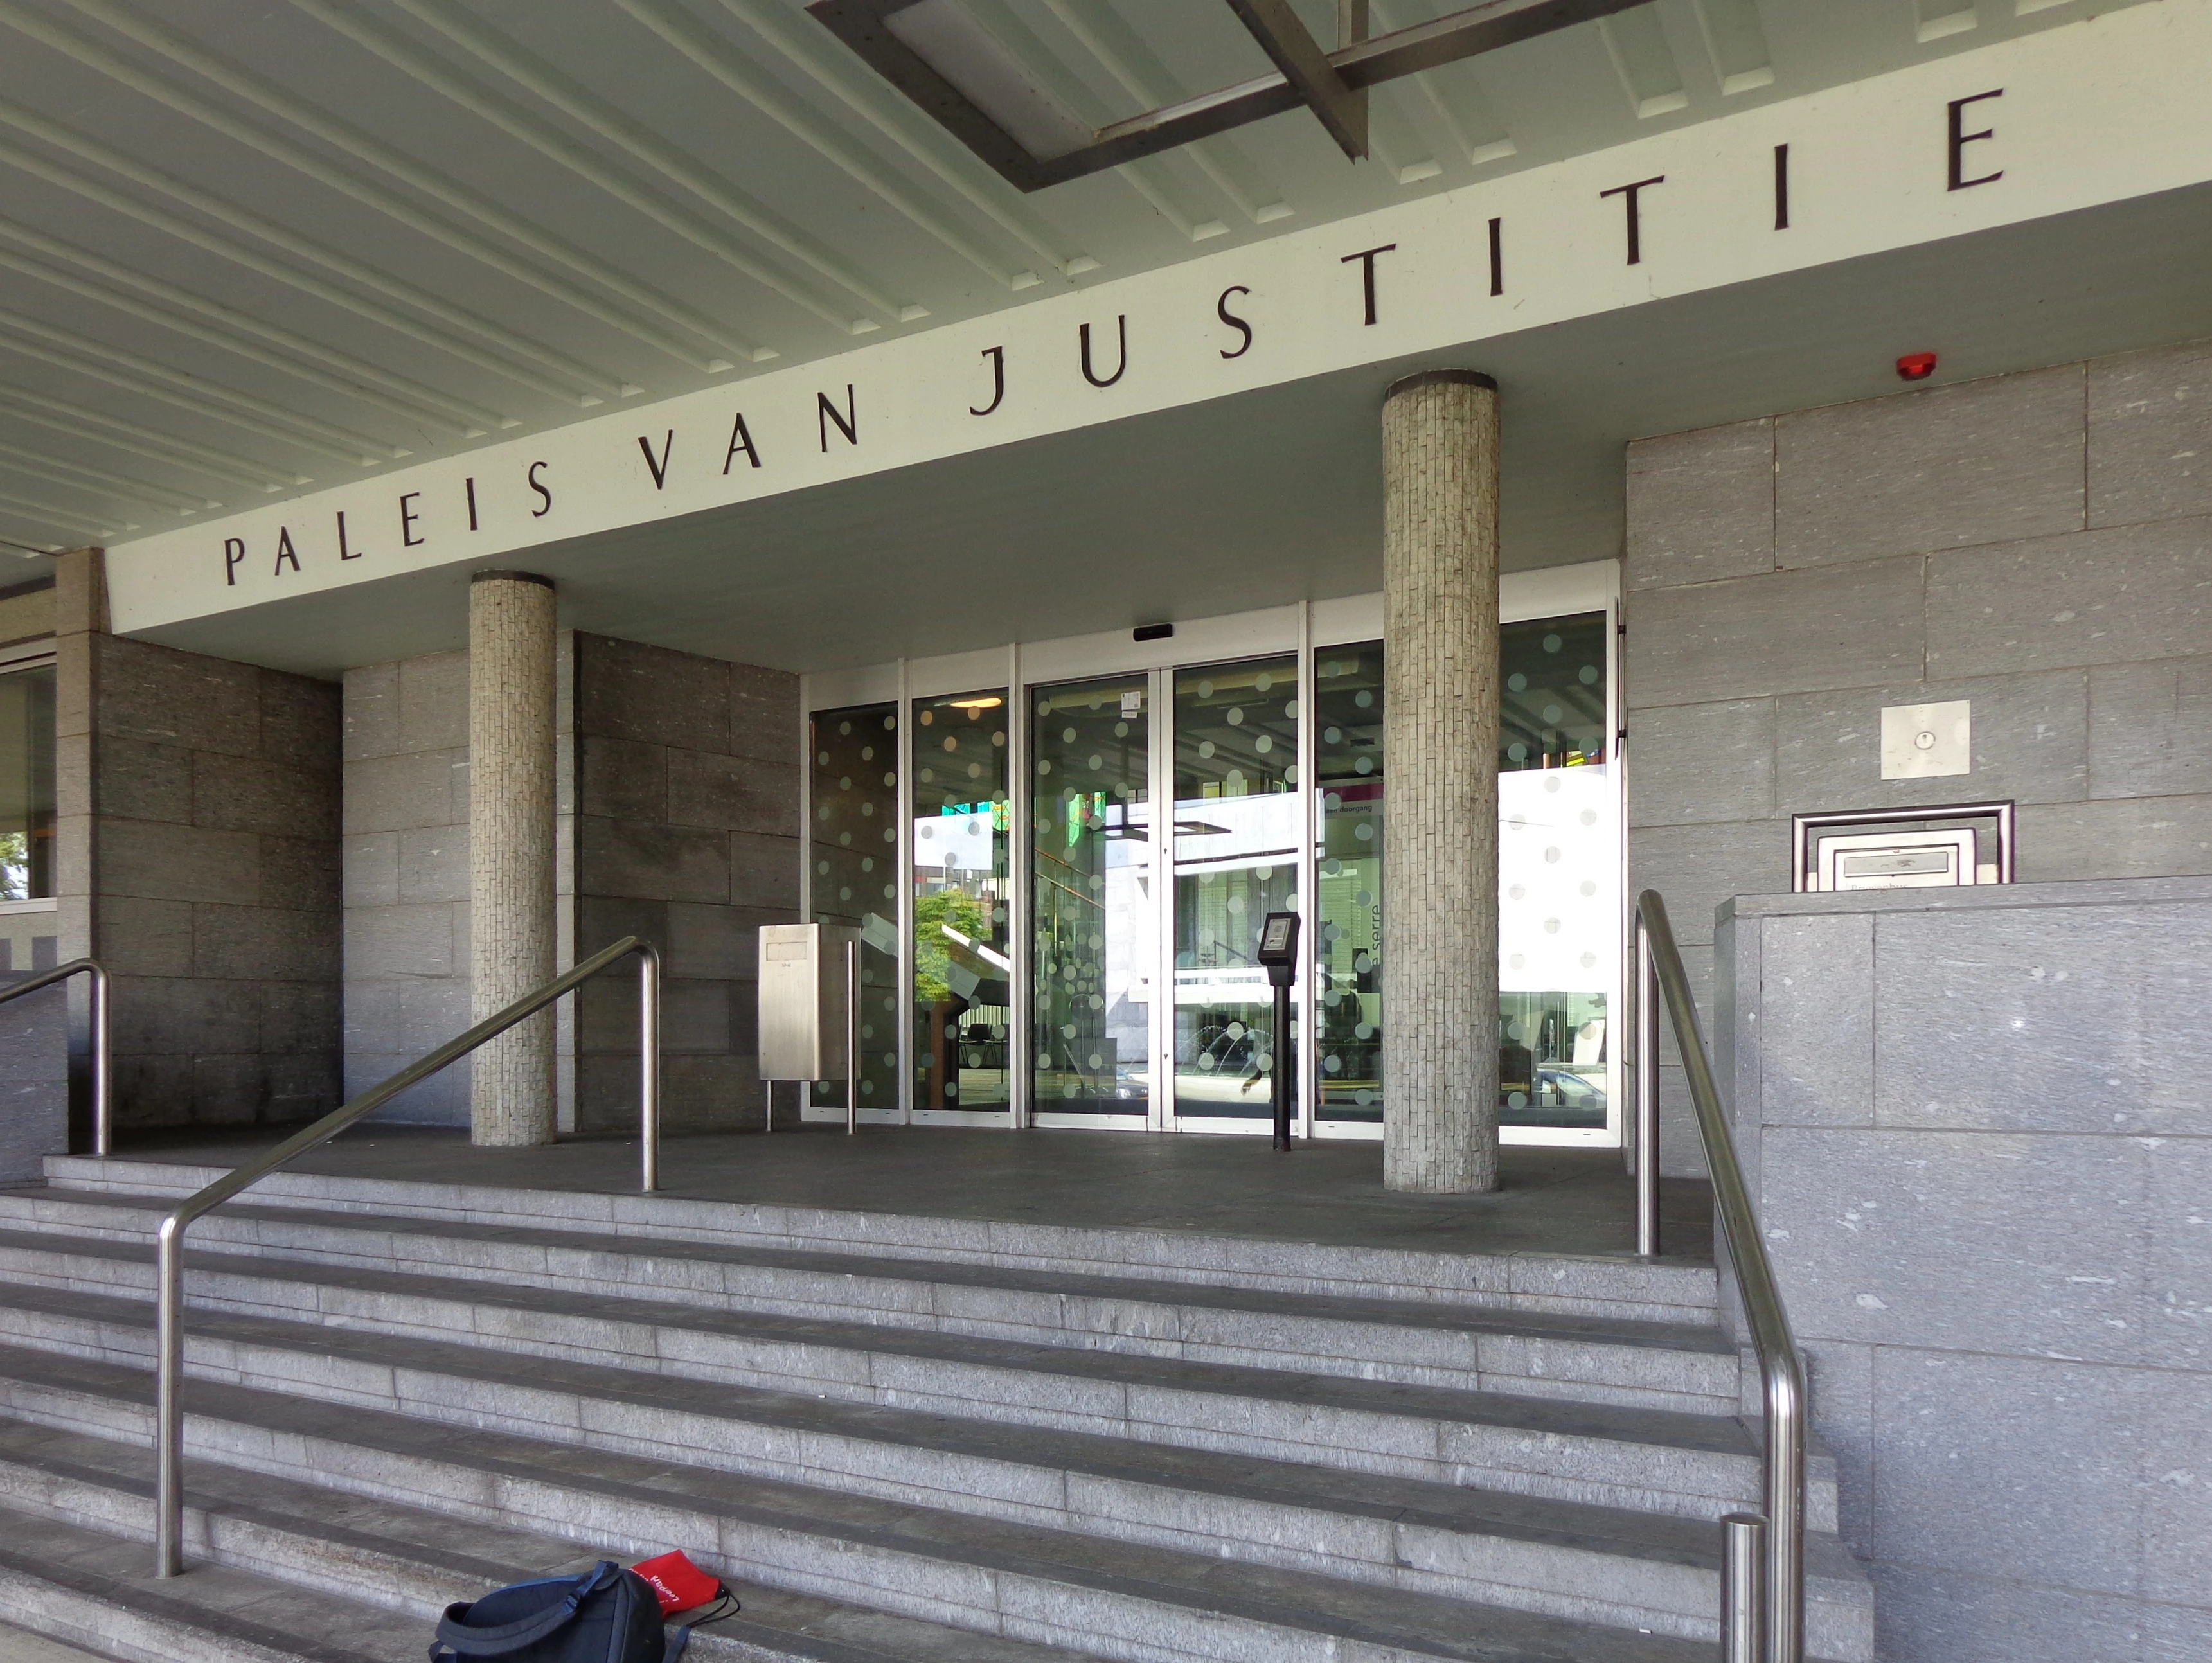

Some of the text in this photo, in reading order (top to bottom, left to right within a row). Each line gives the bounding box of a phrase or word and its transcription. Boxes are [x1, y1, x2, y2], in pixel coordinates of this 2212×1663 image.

[224, 89, 2005, 586] PALEIS VAN JUSTITIE
[1371, 905, 1380, 951] serre
[650, 1575, 679, 1601] Leerpark
